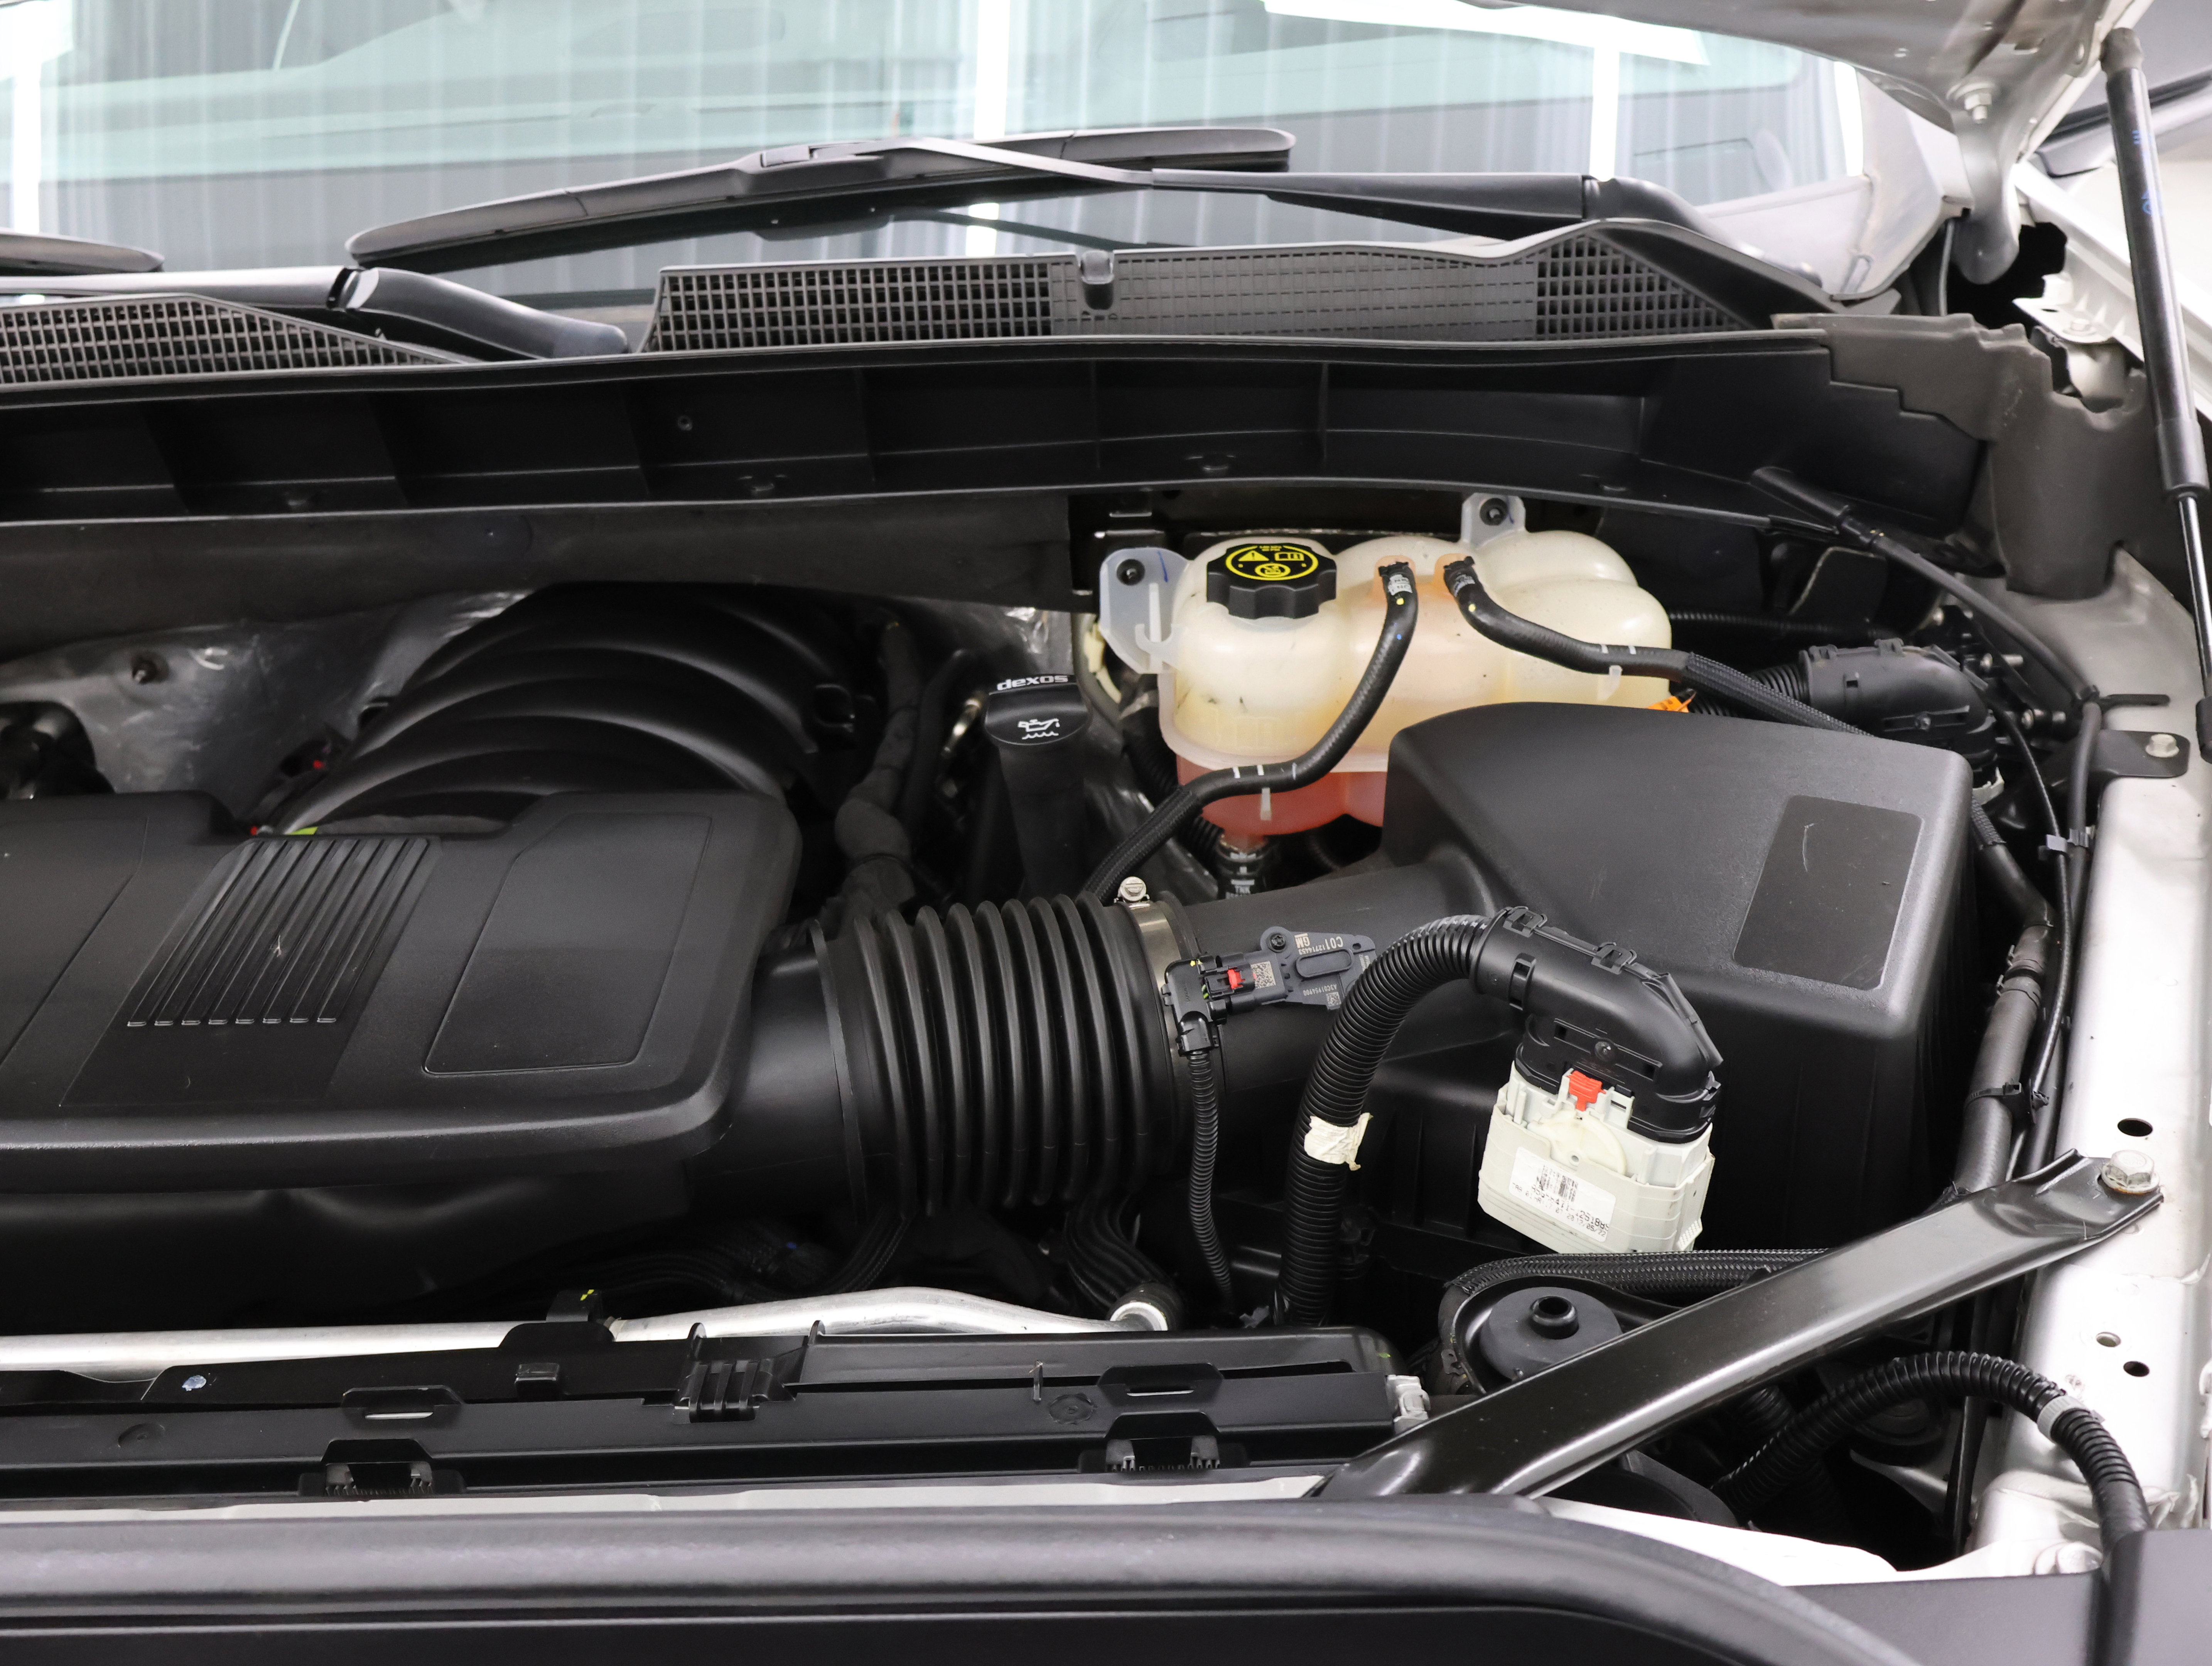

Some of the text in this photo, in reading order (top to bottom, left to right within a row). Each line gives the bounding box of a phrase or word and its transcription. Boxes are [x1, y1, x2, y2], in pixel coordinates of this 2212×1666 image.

[997, 675, 1068, 691] dexos
[1295, 936, 1310, 949] GM
[1298, 936, 1343, 955] C01 12714453
